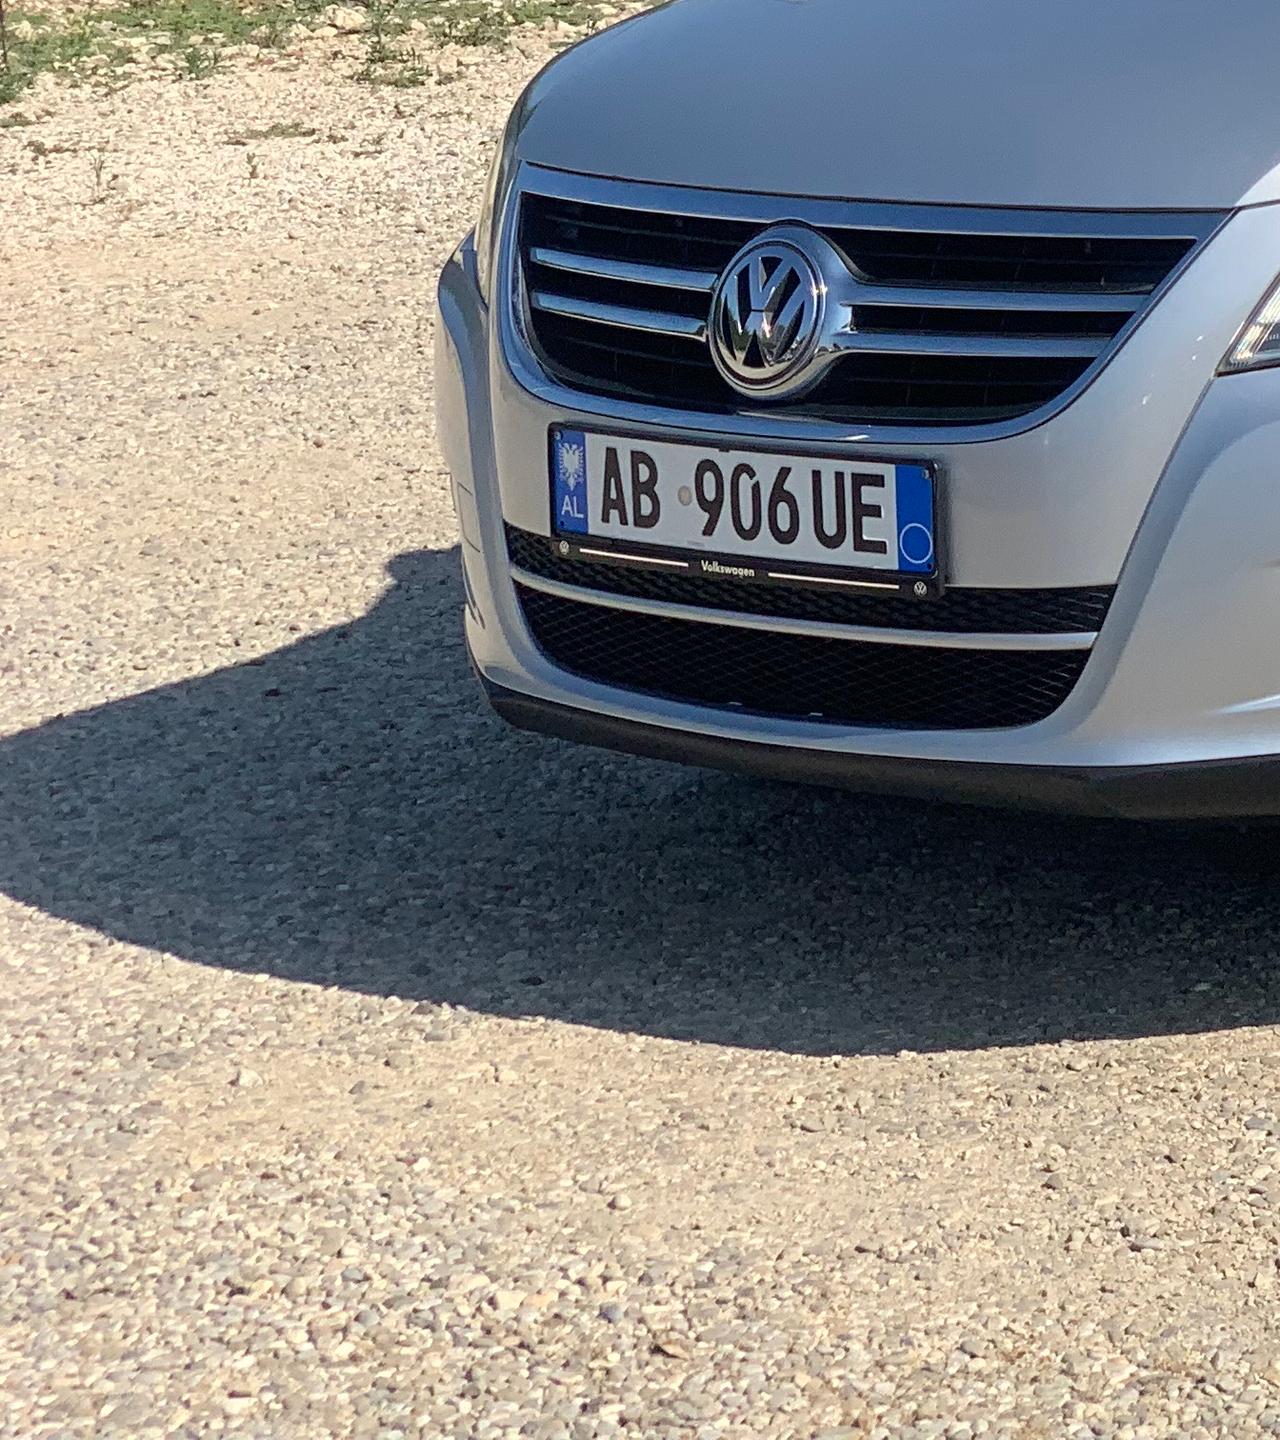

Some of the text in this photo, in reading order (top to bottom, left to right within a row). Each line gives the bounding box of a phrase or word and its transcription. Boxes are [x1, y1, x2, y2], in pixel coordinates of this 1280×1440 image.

[561, 494, 584, 519] AL
[601, 446, 887, 555] AB 906 UE
[701, 560, 756, 578] Volkswagen
